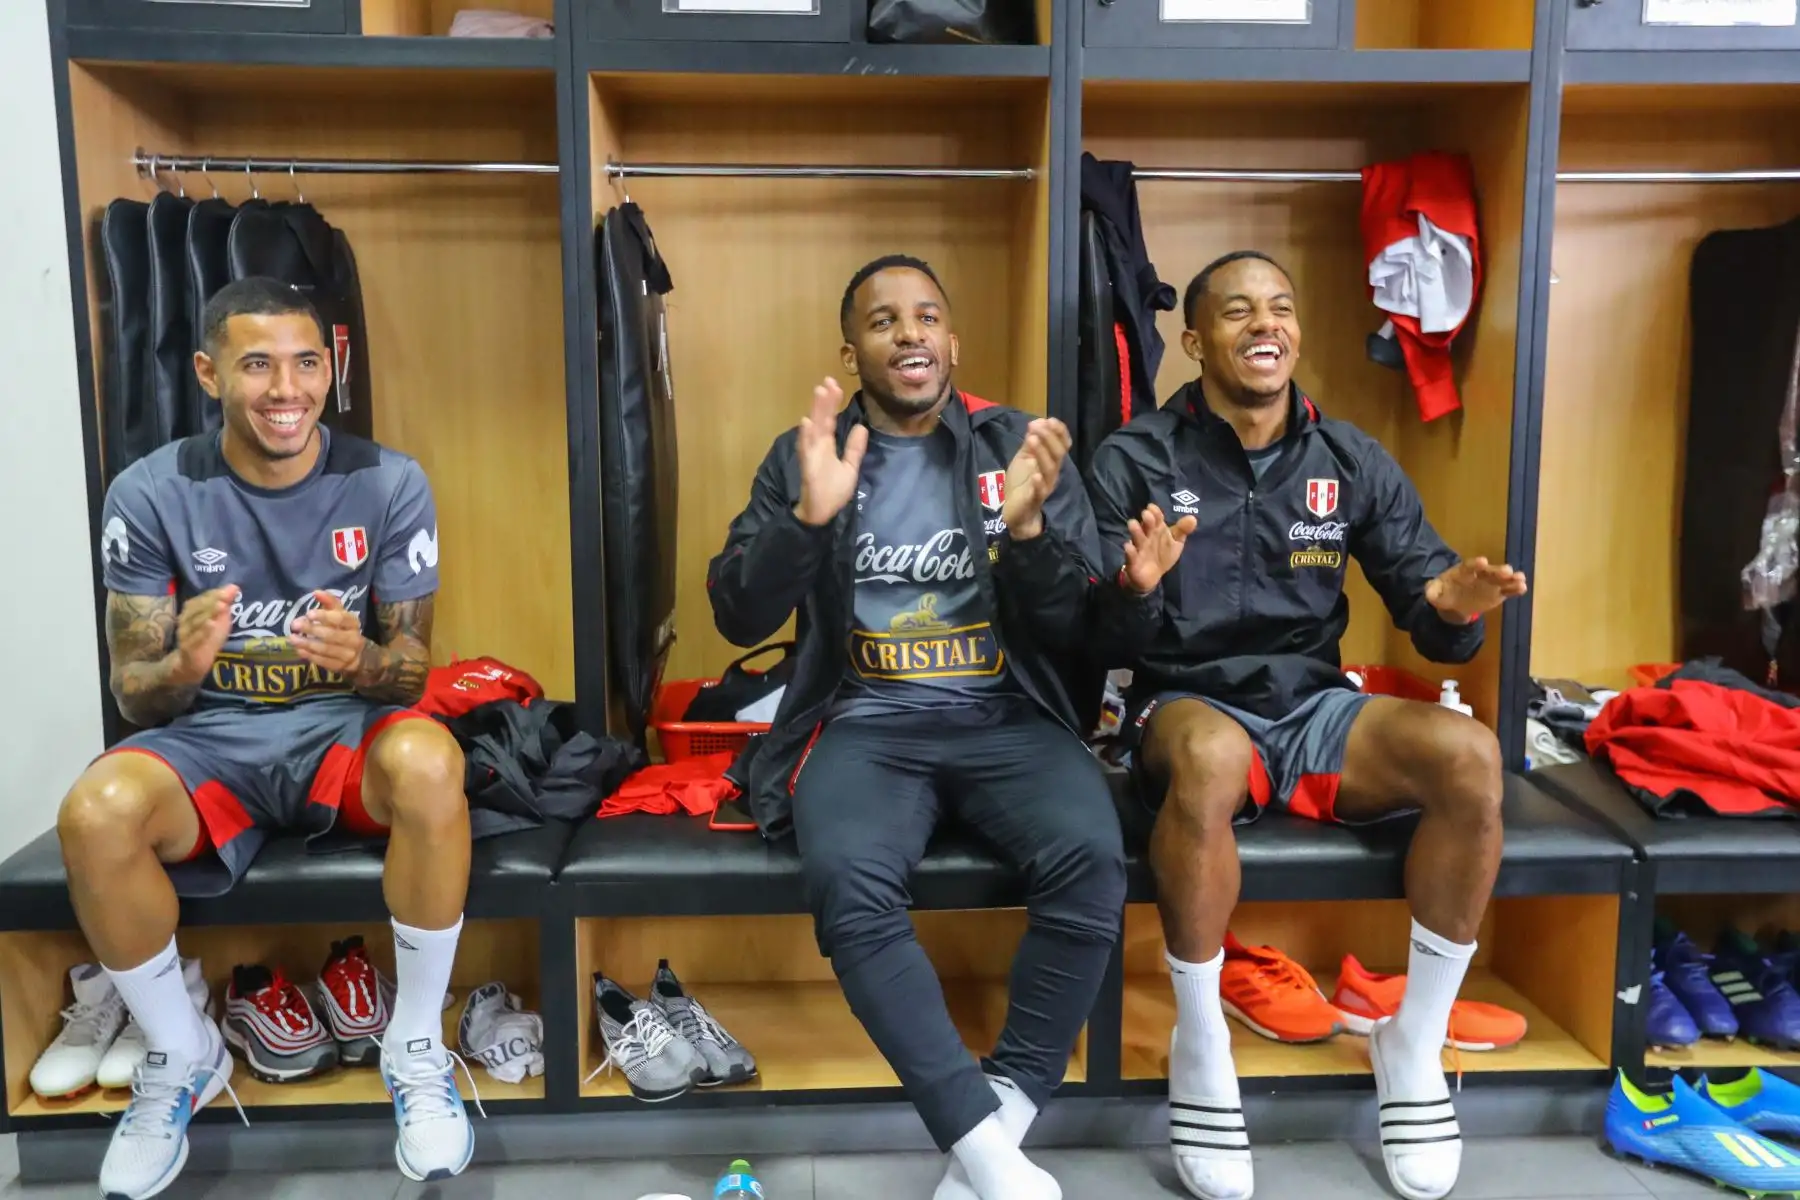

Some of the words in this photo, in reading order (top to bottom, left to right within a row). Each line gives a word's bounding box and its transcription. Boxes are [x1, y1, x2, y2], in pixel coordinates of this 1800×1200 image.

[1172, 504, 1199, 513] umbro
[1288, 521, 1349, 541] Coca-Cola
[1294, 554, 1334, 565] CRISTAL
[194, 563, 226, 573] umbro
[861, 636, 986, 670] CRISTAL
